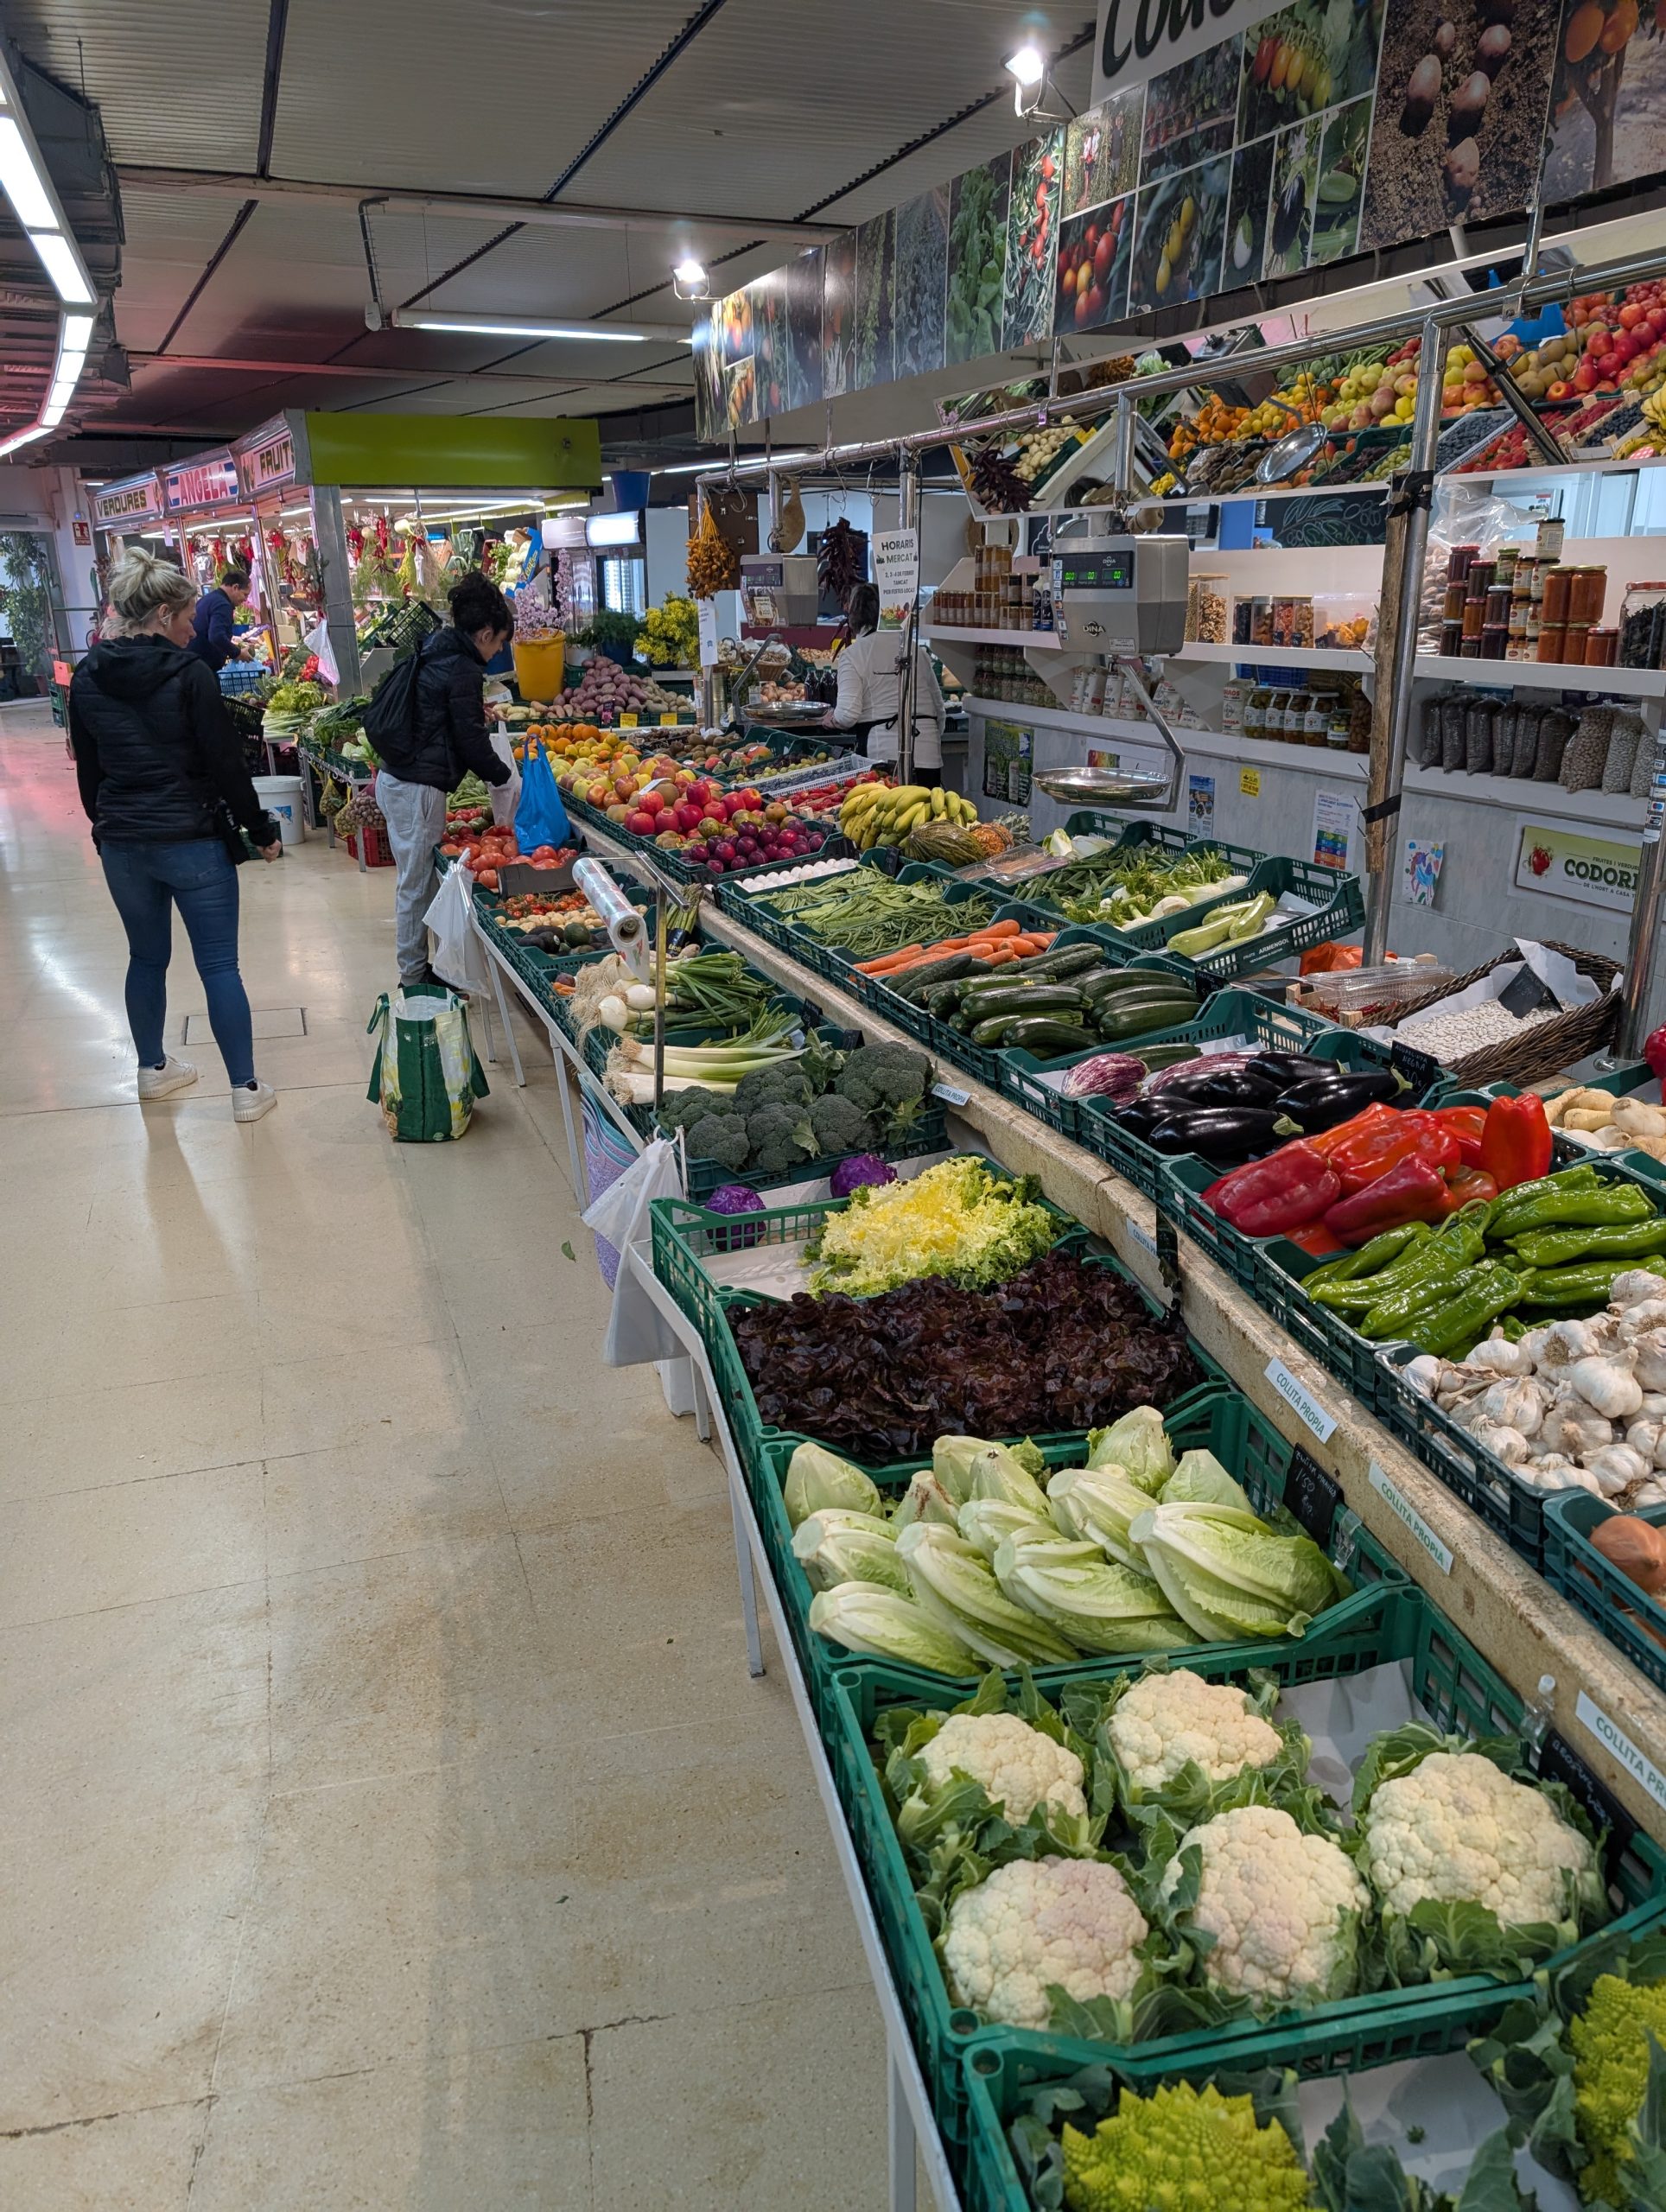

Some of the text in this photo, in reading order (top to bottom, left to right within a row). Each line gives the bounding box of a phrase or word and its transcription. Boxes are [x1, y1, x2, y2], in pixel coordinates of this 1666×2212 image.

[180, 463, 228, 505] ANGELA
[97, 488, 147, 517] VERDURES
[881, 538, 914, 550] HORARIS
[886, 553, 912, 564] MERCAT
[1083, 625, 1104, 633] DINA
[1593, 856, 1613, 865] FRUITES
[1591, 884, 1609, 893] L'HORT
[1616, 889, 1630, 898] CASA
[1258, 938, 1289, 955] ARMENGOL
[1402, 1055, 1426, 1071] NEGRA
[935, 1085, 966, 1104] COLLITA PROPIA
[1133, 1229, 1150, 1249] COLLITA
[1275, 1372, 1326, 1436] COLLITA PROPIA
[1381, 1481, 1445, 1567] COLLITA PROPIA
[1595, 1716, 1666, 1799] COLLITA PR
